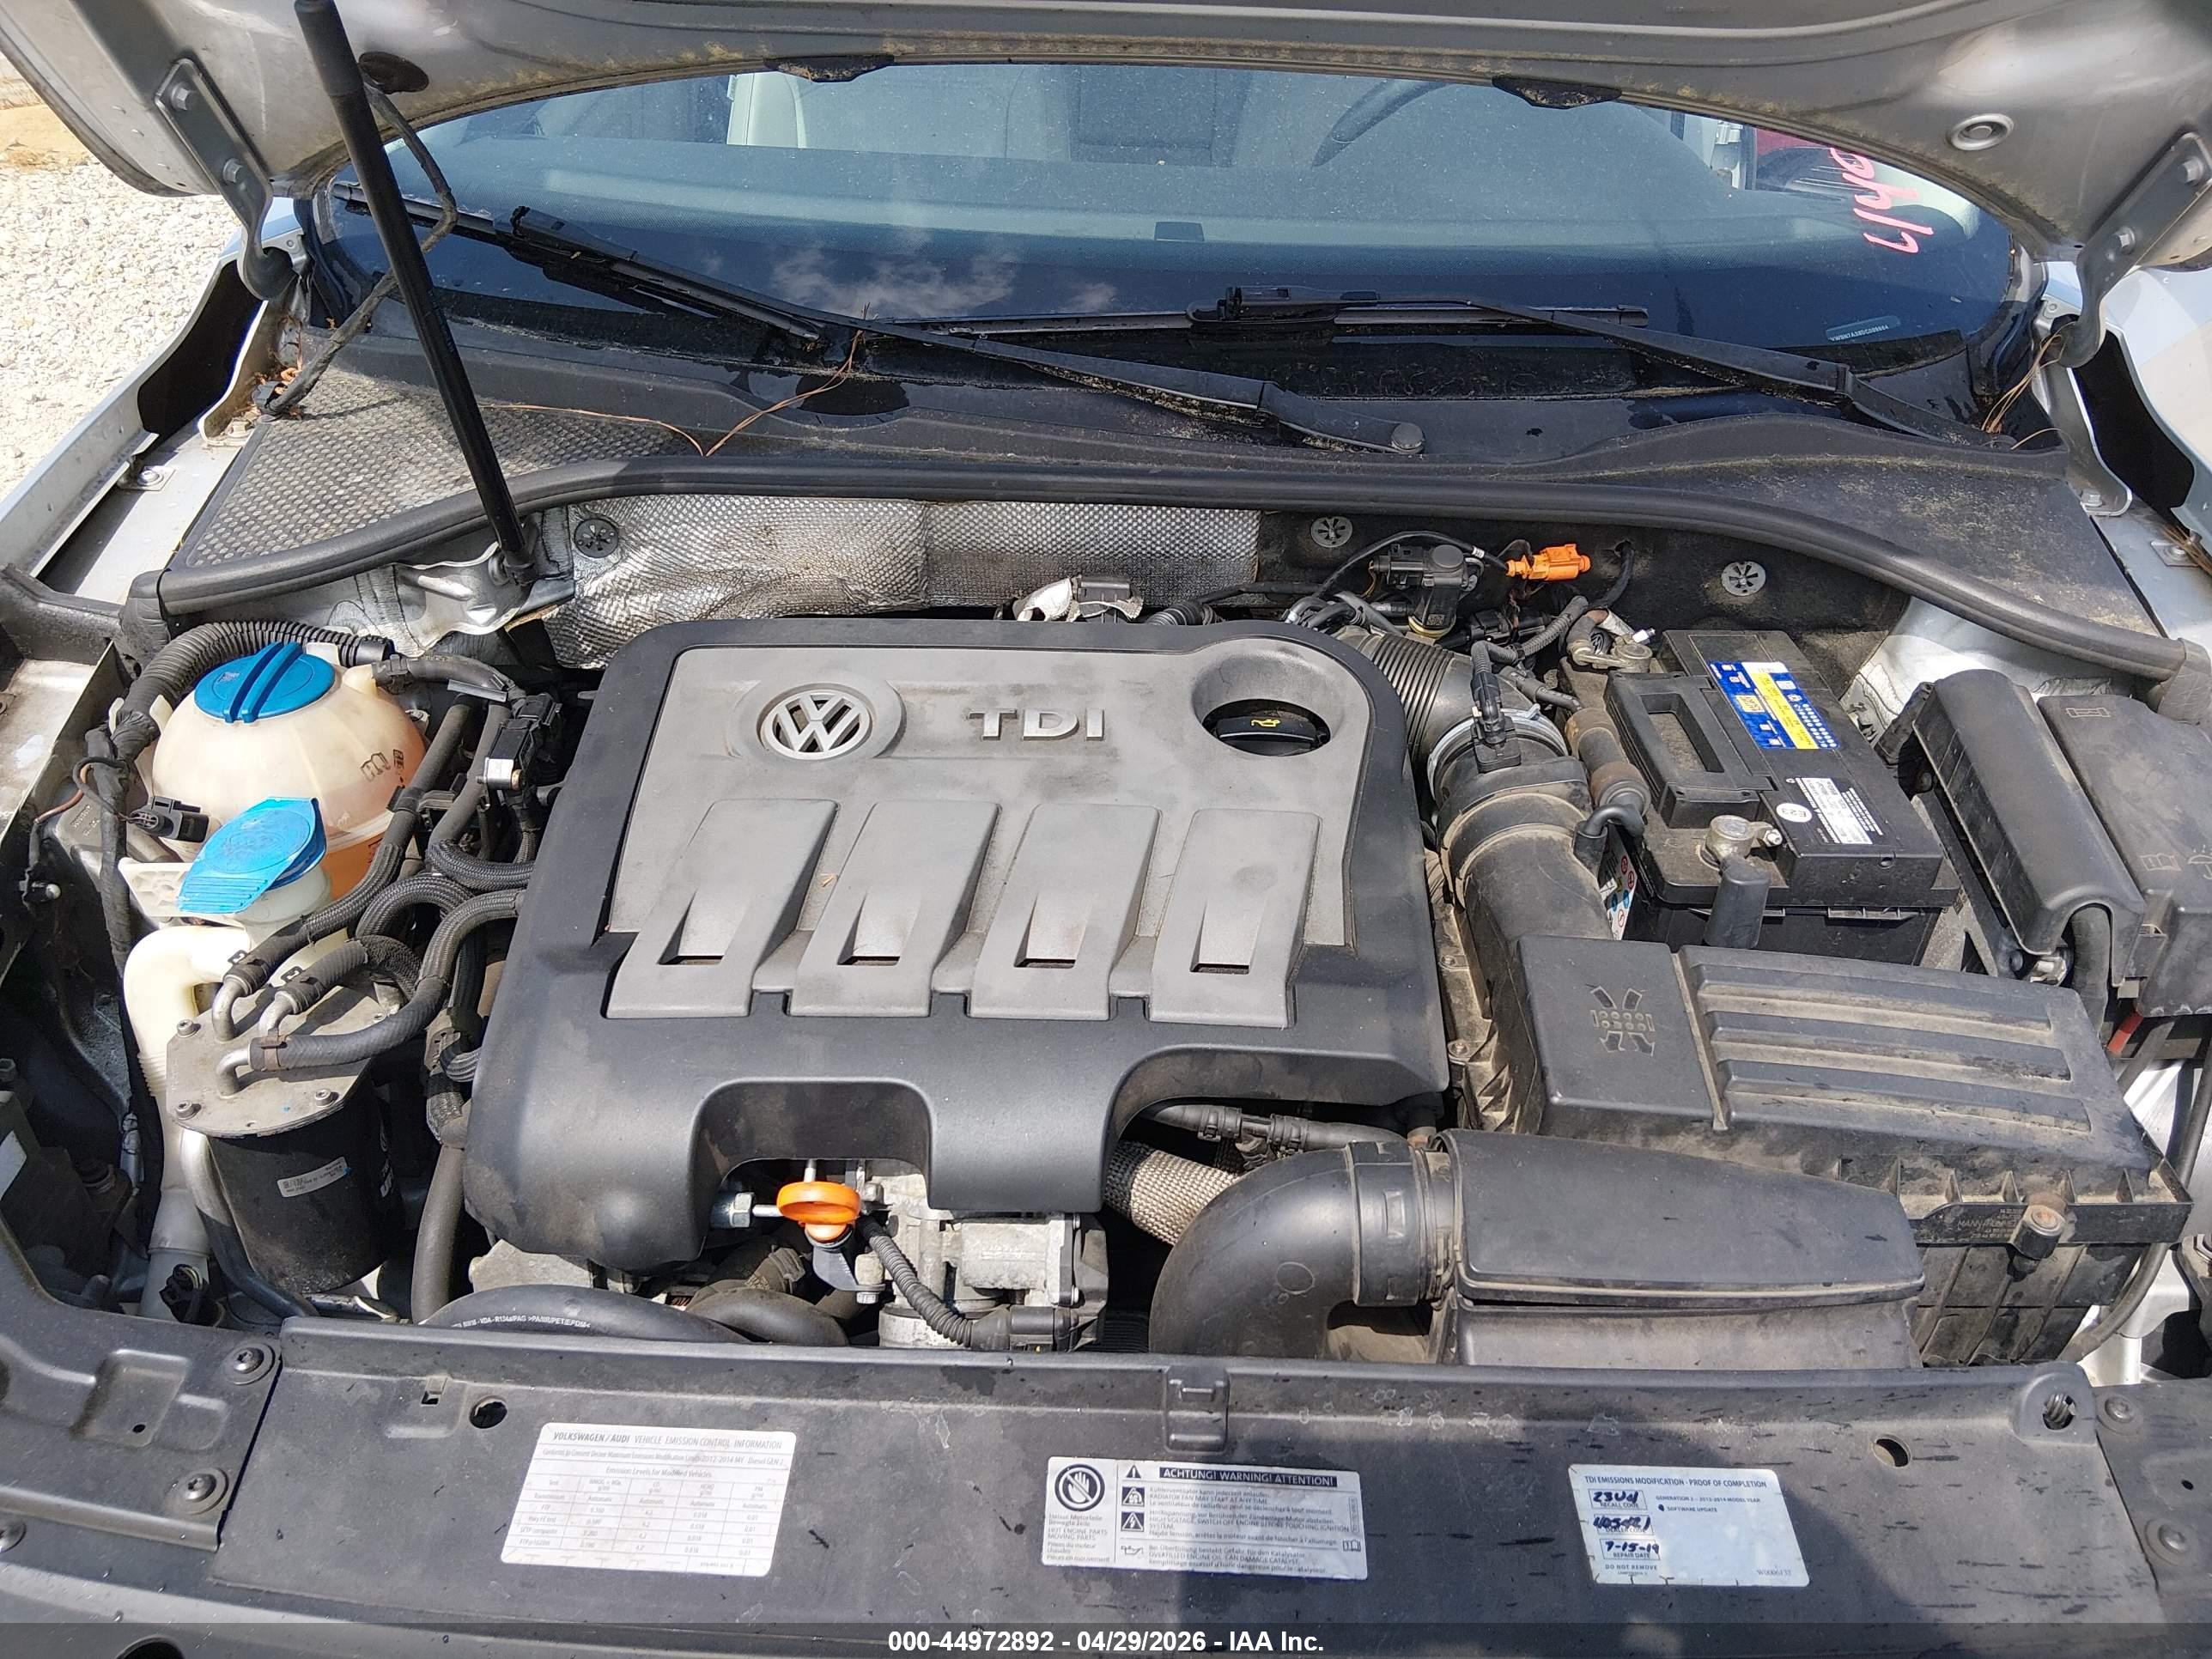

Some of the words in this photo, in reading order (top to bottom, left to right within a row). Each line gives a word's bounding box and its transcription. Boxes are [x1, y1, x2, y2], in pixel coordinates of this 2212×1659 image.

[969, 708, 1105, 740] TDI
[552, 1430, 605, 1442] VOLKSWAGEN
[604, 1432, 611, 1442] /
[609, 1432, 631, 1443] AUDI
[633, 1434, 663, 1444] VEHICLE
[664, 1435, 699, 1446] EMISSION
[698, 1437, 731, 1448] CONTROL
[732, 1438, 782, 1450] INFORMATION
[605, 1465, 633, 1474] Emission
[631, 1467, 651, 1475] Levels
[649, 1468, 661, 1476] for
[659, 1468, 688, 1477] Modified
[687, 1469, 713, 1479] Vehicles
[1164, 1468, 1216, 1480] ACHTUNG!
[1219, 1470, 1272, 1482] WARNING!
[1274, 1474, 1332, 1485] ATTENTION!
[1584, 1475, 1597, 1484] TDI
[1596, 1475, 1634, 1485] EMISSIONS
[1633, 1476, 1685, 1486] MODIFICATION
[1687, 1478, 1712, 1486] PROOF
[1711, 1479, 1723, 1487] OF
[1722, 1479, 1768, 1488] COMPLETION
[1149, 1492, 1179, 1501] RADIATOR
[1148, 1516, 1165, 1524] HIGH
[1198, 1518, 1223, 1527] SWITCH
[1237, 1520, 1259, 1528] ENGINE
[1285, 1522, 1319, 1531] TOUCHING
[1320, 1523, 1350, 1532] IGNITION
[1187, 1553, 1210, 1561] ENGINE
